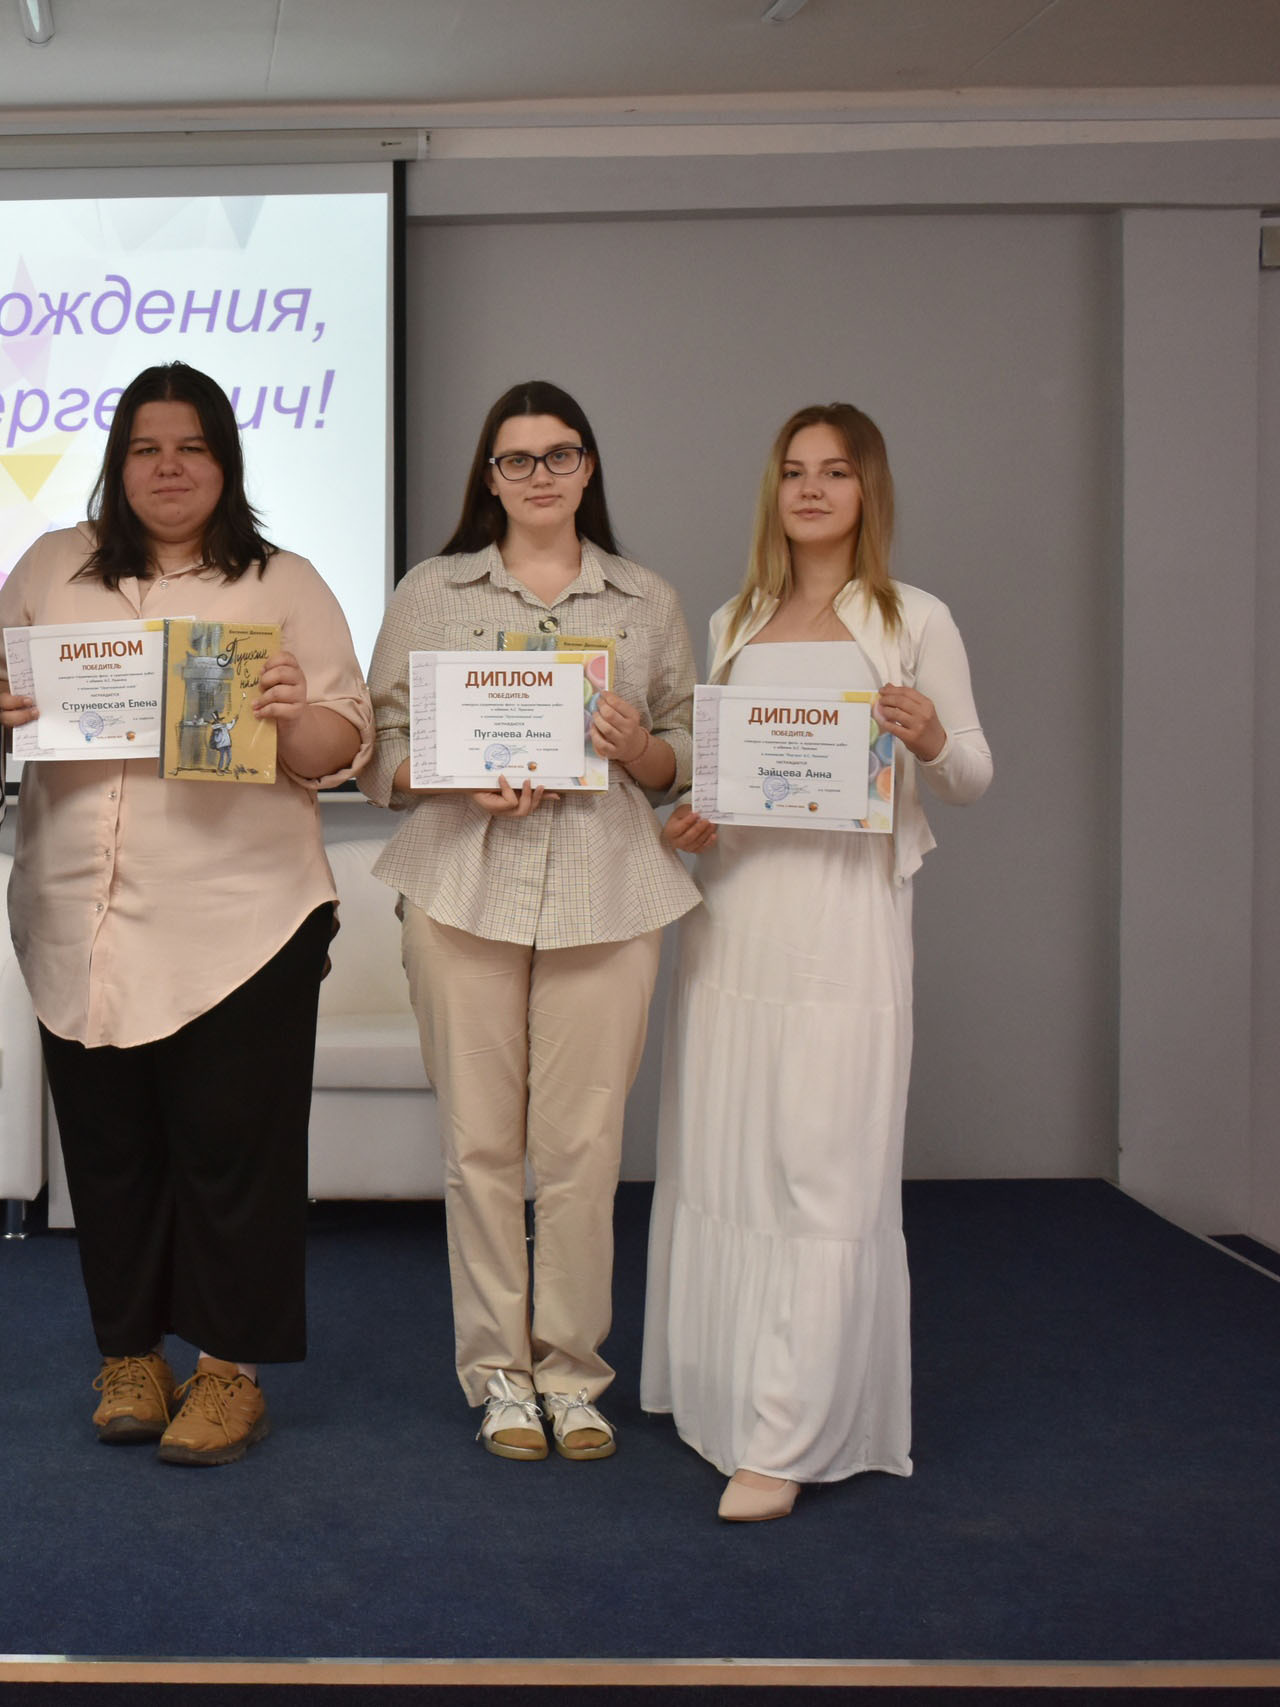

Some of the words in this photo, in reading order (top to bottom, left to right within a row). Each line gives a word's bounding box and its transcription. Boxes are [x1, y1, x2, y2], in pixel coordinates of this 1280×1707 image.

[59, 640, 143, 662] ДИПЛОМ
[82, 663, 122, 671] ПОБЕДИТЕЛЬ
[465, 671, 553, 689] ДИПЛОМ
[62, 701, 126, 713] Струневская
[128, 699, 158, 709] Елена
[748, 707, 838, 726] ДИПЛОМ
[474, 729, 522, 740] Пугачева
[525, 729, 551, 739] Анна
[771, 729, 814, 738] ПОБЕДИТЕЛЬ
[757, 766, 802, 778] Зайцева
[805, 768, 832, 779] Анна
